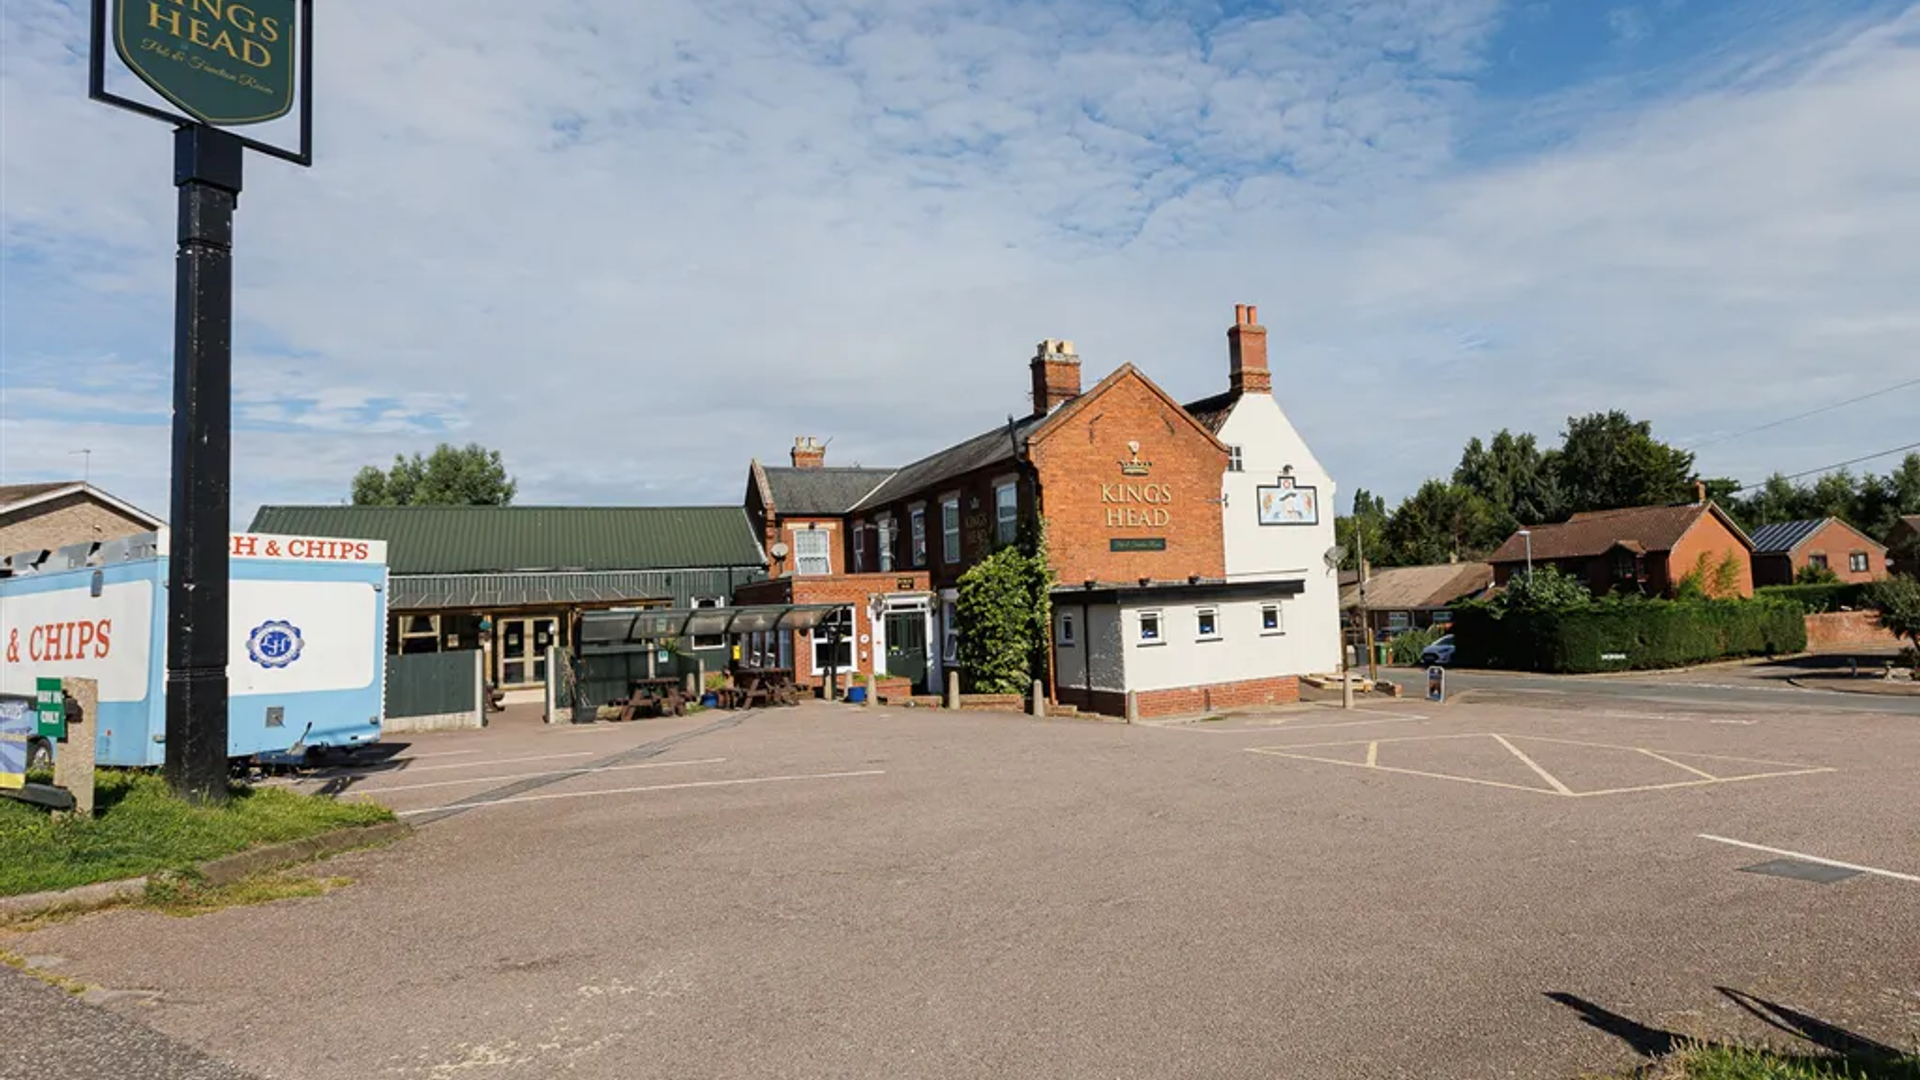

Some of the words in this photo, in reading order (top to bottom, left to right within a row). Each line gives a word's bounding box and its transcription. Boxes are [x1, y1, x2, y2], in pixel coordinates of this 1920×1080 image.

[147, 1, 271, 67] HEAD
[1100, 483, 1172, 504] KINGS
[1105, 508, 1171, 527] HEAD
[231, 536, 259, 556] H
[265, 540, 281, 556] &
[288, 540, 370, 560] CHIPS
[6, 628, 20, 662] &
[30, 619, 112, 661] CHIPS
